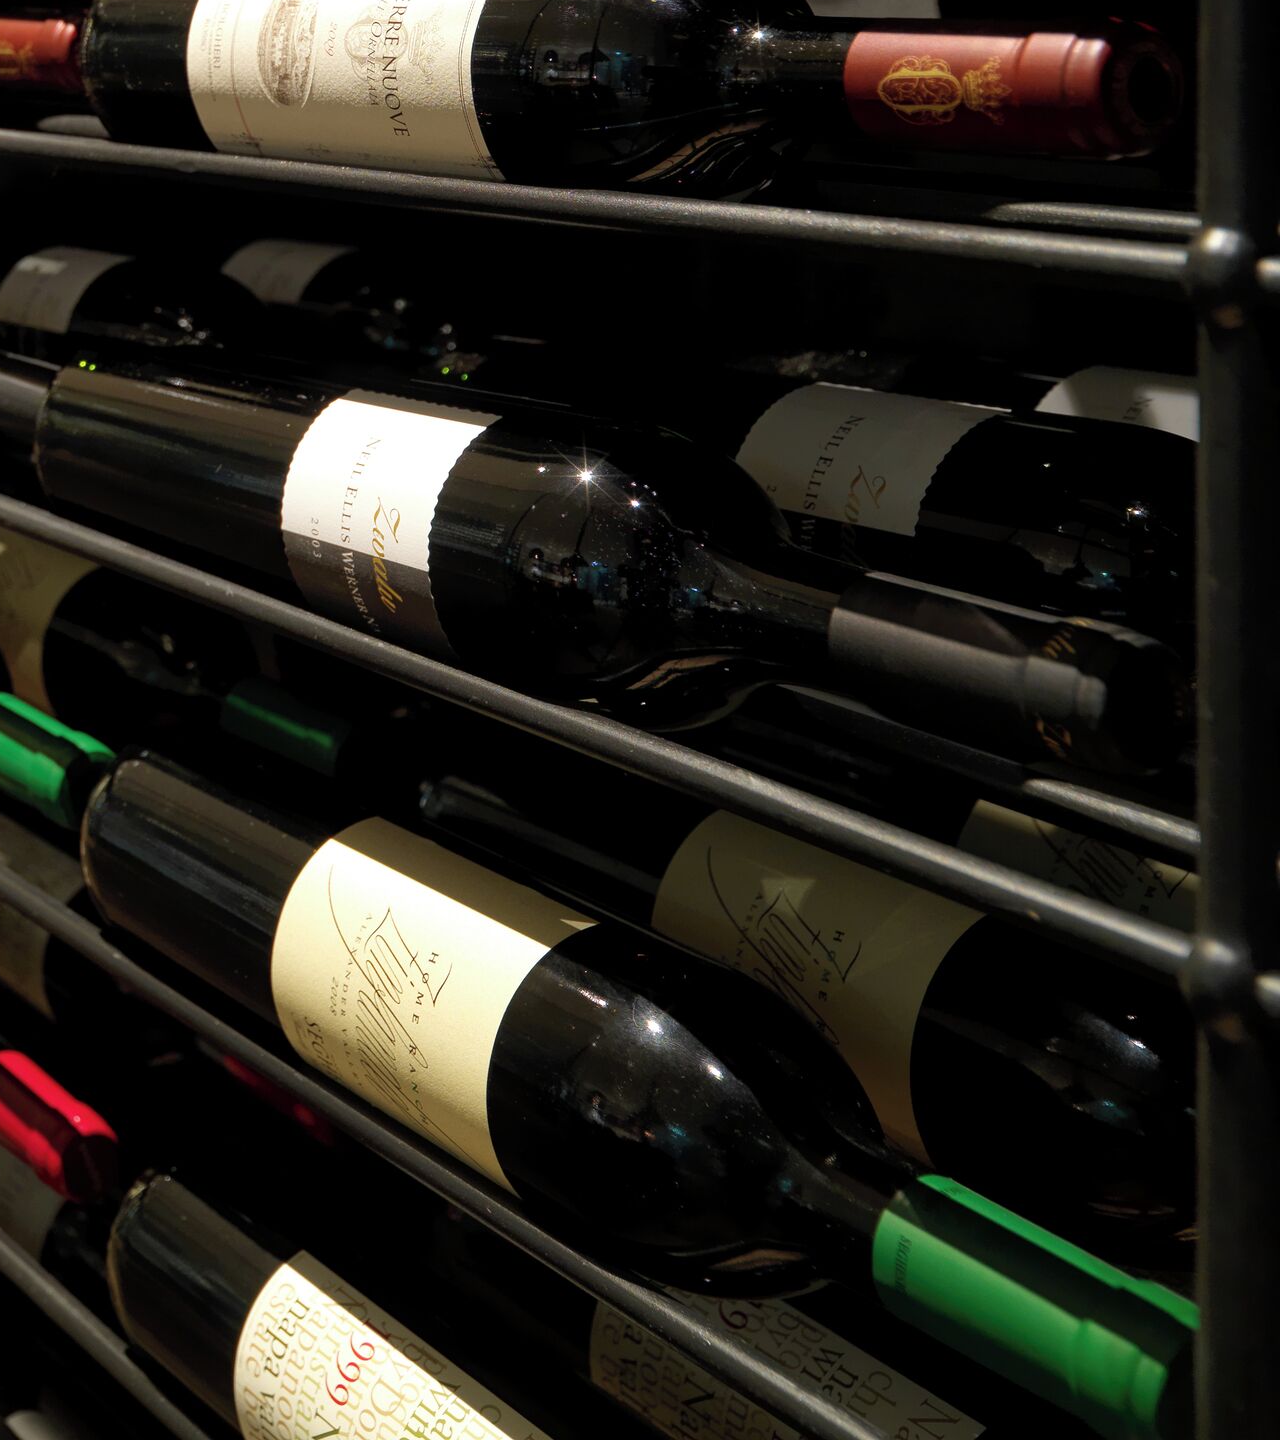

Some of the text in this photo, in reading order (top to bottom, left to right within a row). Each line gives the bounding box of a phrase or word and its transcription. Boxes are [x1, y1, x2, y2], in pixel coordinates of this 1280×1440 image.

[326, 21, 338, 57] 2009
[381, 55, 410, 138] NUOVE
[834, 414, 864, 451] NEIL
[802, 451, 834, 513] ELLIS
[310, 517, 322, 560] 2003
[340, 436, 382, 618] NEIL ELLIS WERNER
[340, 913, 373, 1018] ALEXANDER
[412, 951, 439, 1025] HOME
[818, 930, 845, 1001] HOME
[245, 1282, 296, 1378] estate
[263, 1297, 310, 1378] napa
